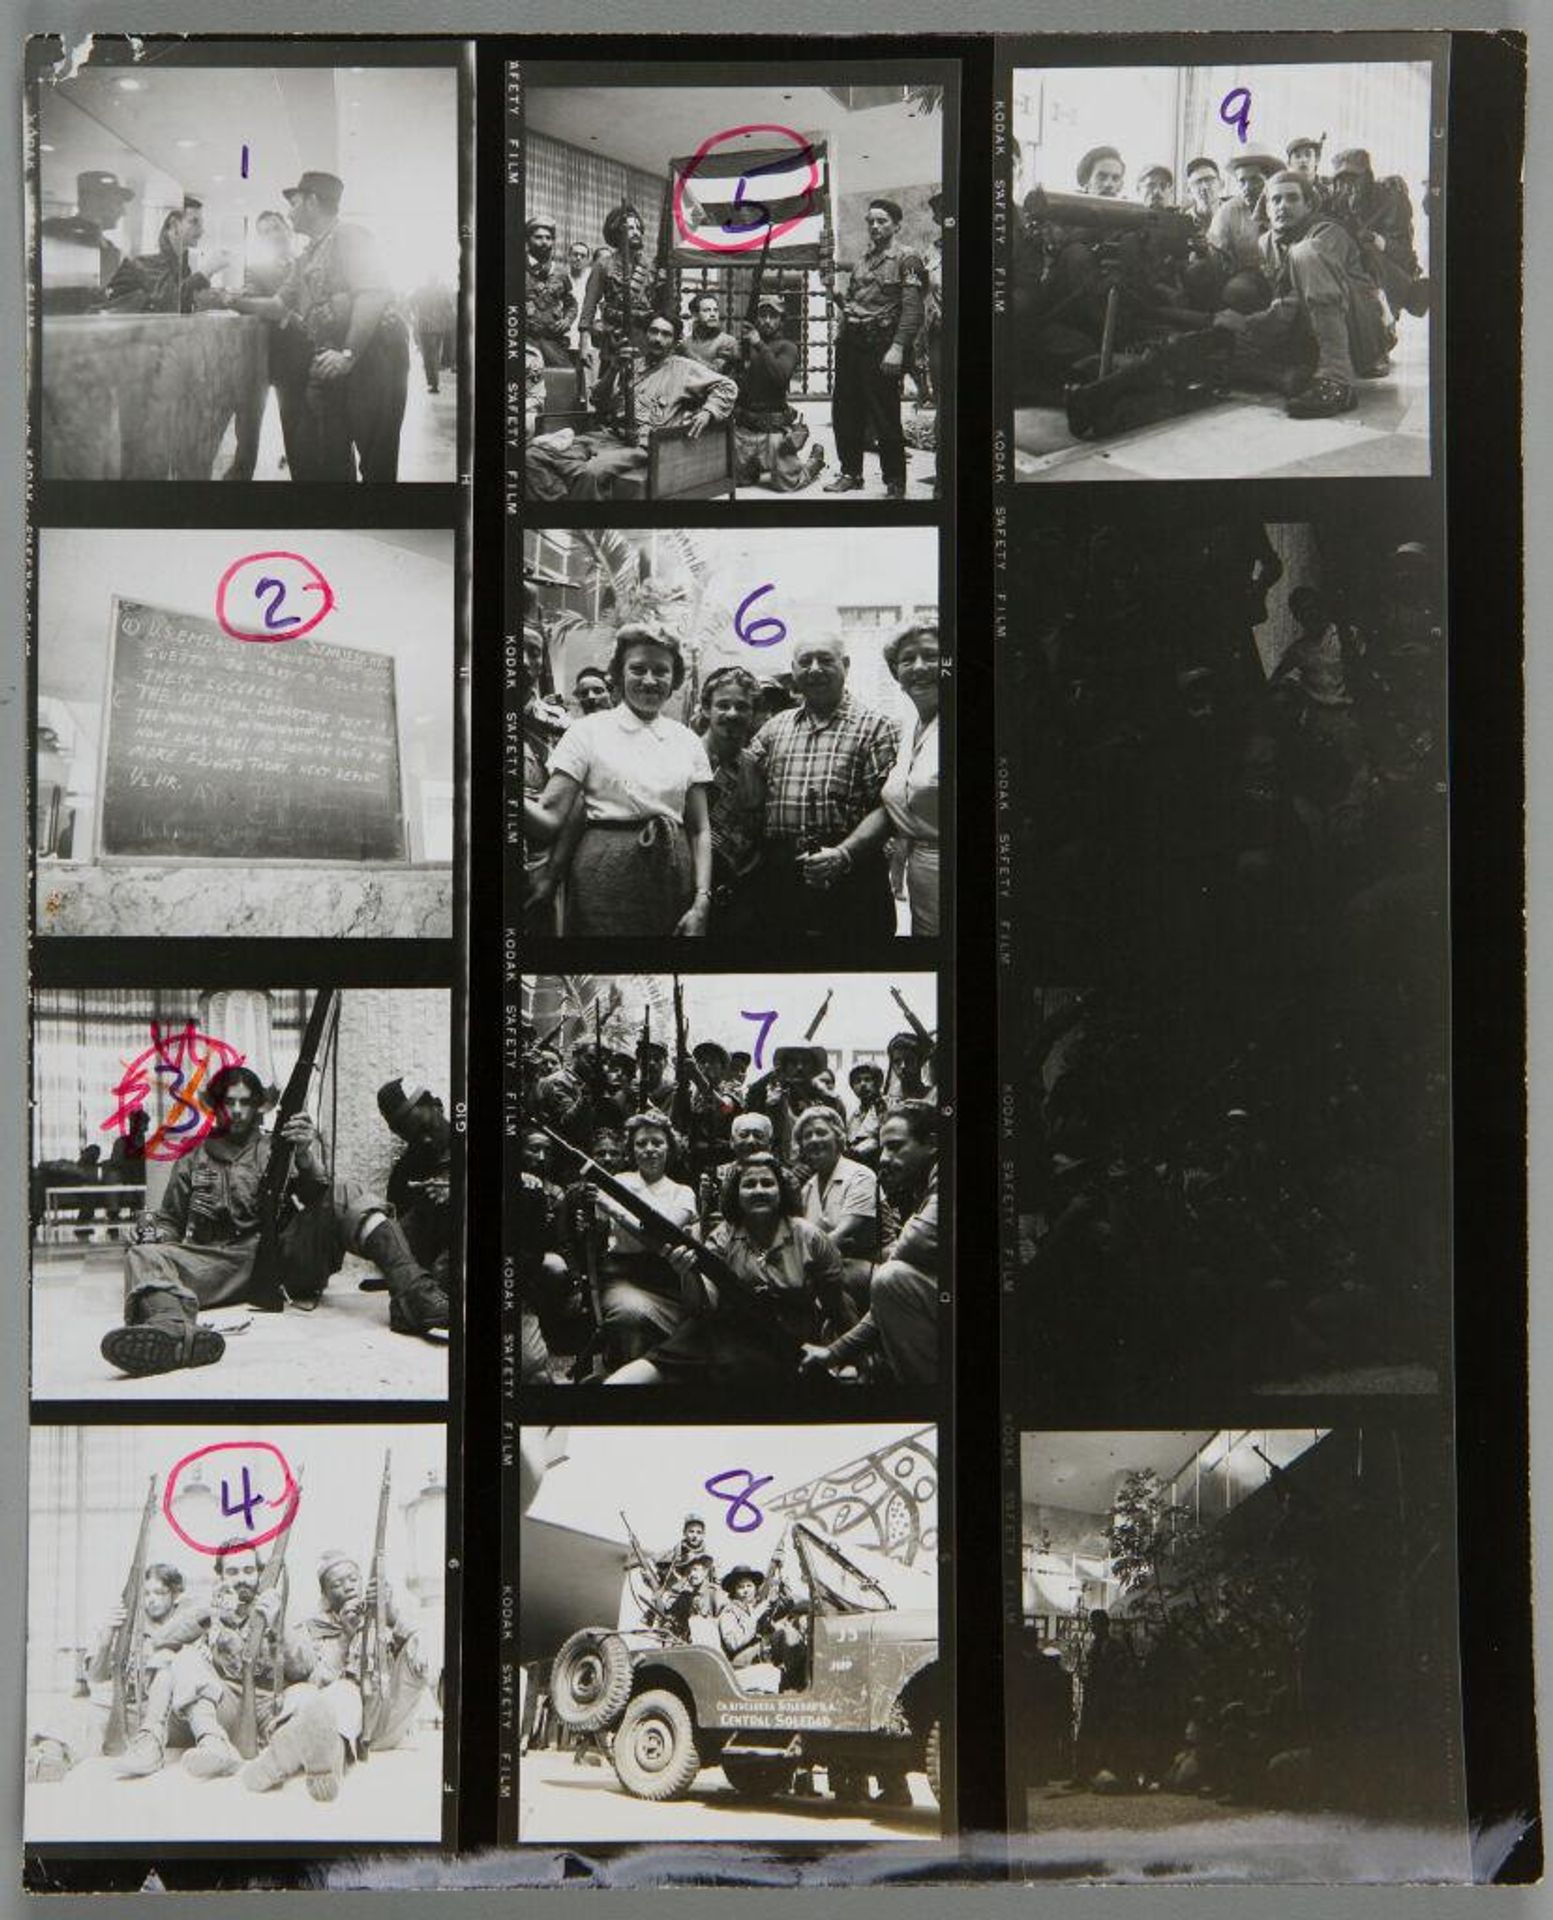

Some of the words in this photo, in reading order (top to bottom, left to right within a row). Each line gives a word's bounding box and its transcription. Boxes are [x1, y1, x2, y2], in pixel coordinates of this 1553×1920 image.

[994, 101, 1005, 156] KODAK
[1221, 88, 1250, 142] 9
[241, 145, 249, 178] 1
[507, 138, 519, 184] FILM
[722, 153, 810, 234] 5
[994, 180, 1006, 244] SAFETY
[994, 268, 1005, 312] FILM
[507, 305, 519, 359] KODAK
[507, 382, 519, 447] SAFETY
[994, 430, 1006, 484] KODAK
[507, 470, 519, 515] FILM
[995, 507, 1007, 570] SAFETY
[256, 580, 301, 629] 2
[735, 584, 786, 647] 6
[995, 594, 1006, 638] FILM
[506, 635, 518, 689] KODAK
[506, 712, 518, 776] SAFETY
[998, 757, 1009, 811] KODAK
[505, 799, 518, 844] FILM
[999, 833, 1010, 897] SAFETY
[505, 928, 517, 982] KODAK
[999, 920, 1010, 965] FILM
[505, 1005, 517, 1069] SAFETY
[740, 1010, 779, 1070] 7
[155, 1065, 200, 1133] 3
[505, 1092, 517, 1136] FILM
[1002, 1083, 1014, 1139] KODAK
[1003, 1161, 1014, 1226] SAFETY
[503, 1257, 515, 1311] KODAK
[1003, 1248, 1014, 1292] FILM
[503, 1333, 515, 1399] SAFETY
[503, 1422, 515, 1466] FILM
[222, 1467, 262, 1529] 4
[704, 1470, 773, 1531] 8
[501, 1585, 513, 1639] KODAK
[501, 1664, 513, 1729] SAFETY
[721, 1713, 771, 1727] CENTRAL
[775, 1713, 832, 1728] SOLEDAD
[500, 1753, 511, 1798] FILM
